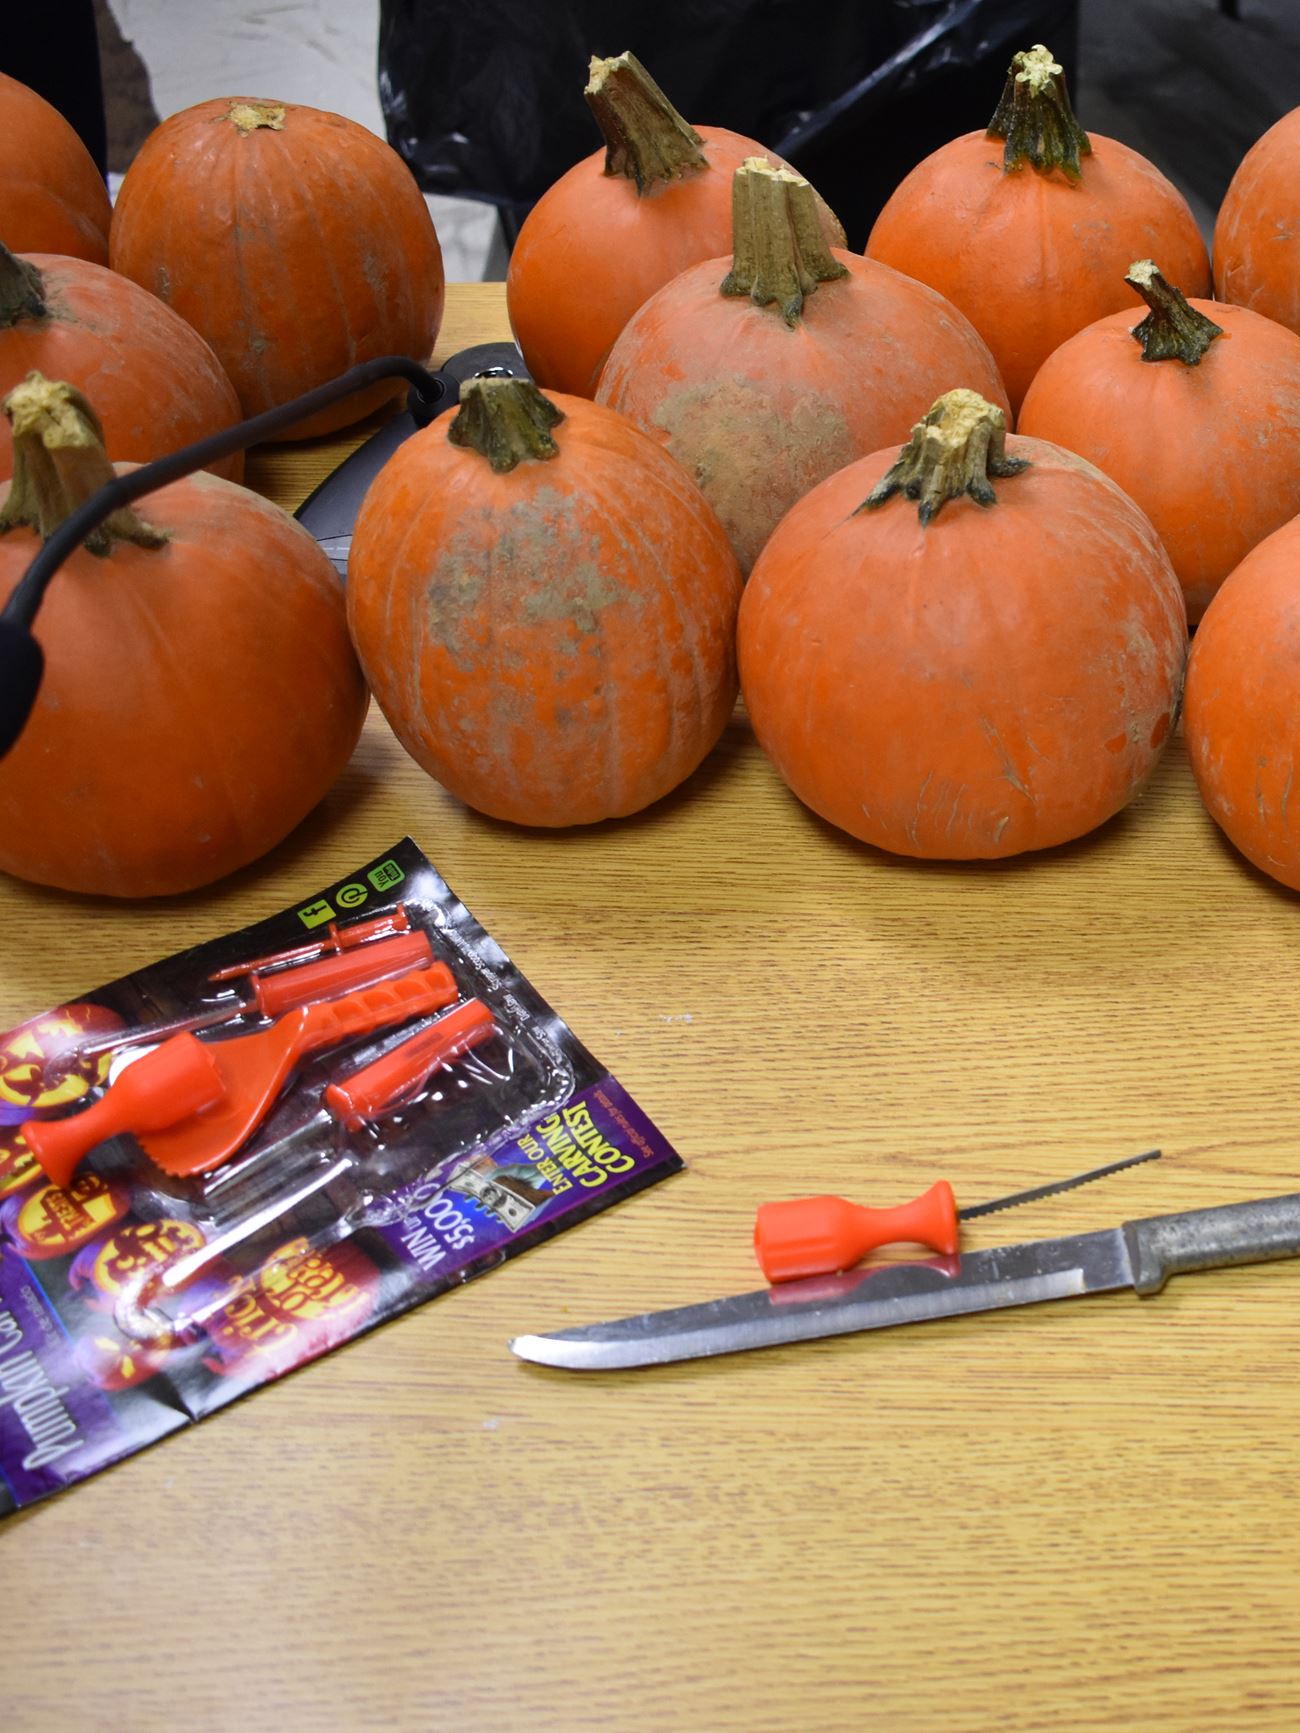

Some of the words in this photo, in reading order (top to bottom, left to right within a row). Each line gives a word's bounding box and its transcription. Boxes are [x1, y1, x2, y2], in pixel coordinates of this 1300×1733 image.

[516, 1133, 546, 1162] OUR
[535, 1111, 609, 1189] CARVING
[562, 1100, 636, 1175] CONTEST
[536, 1156, 574, 1195] ENTER
[412, 1182, 477, 1250] $5,000
[400, 1229, 447, 1272] WIN
